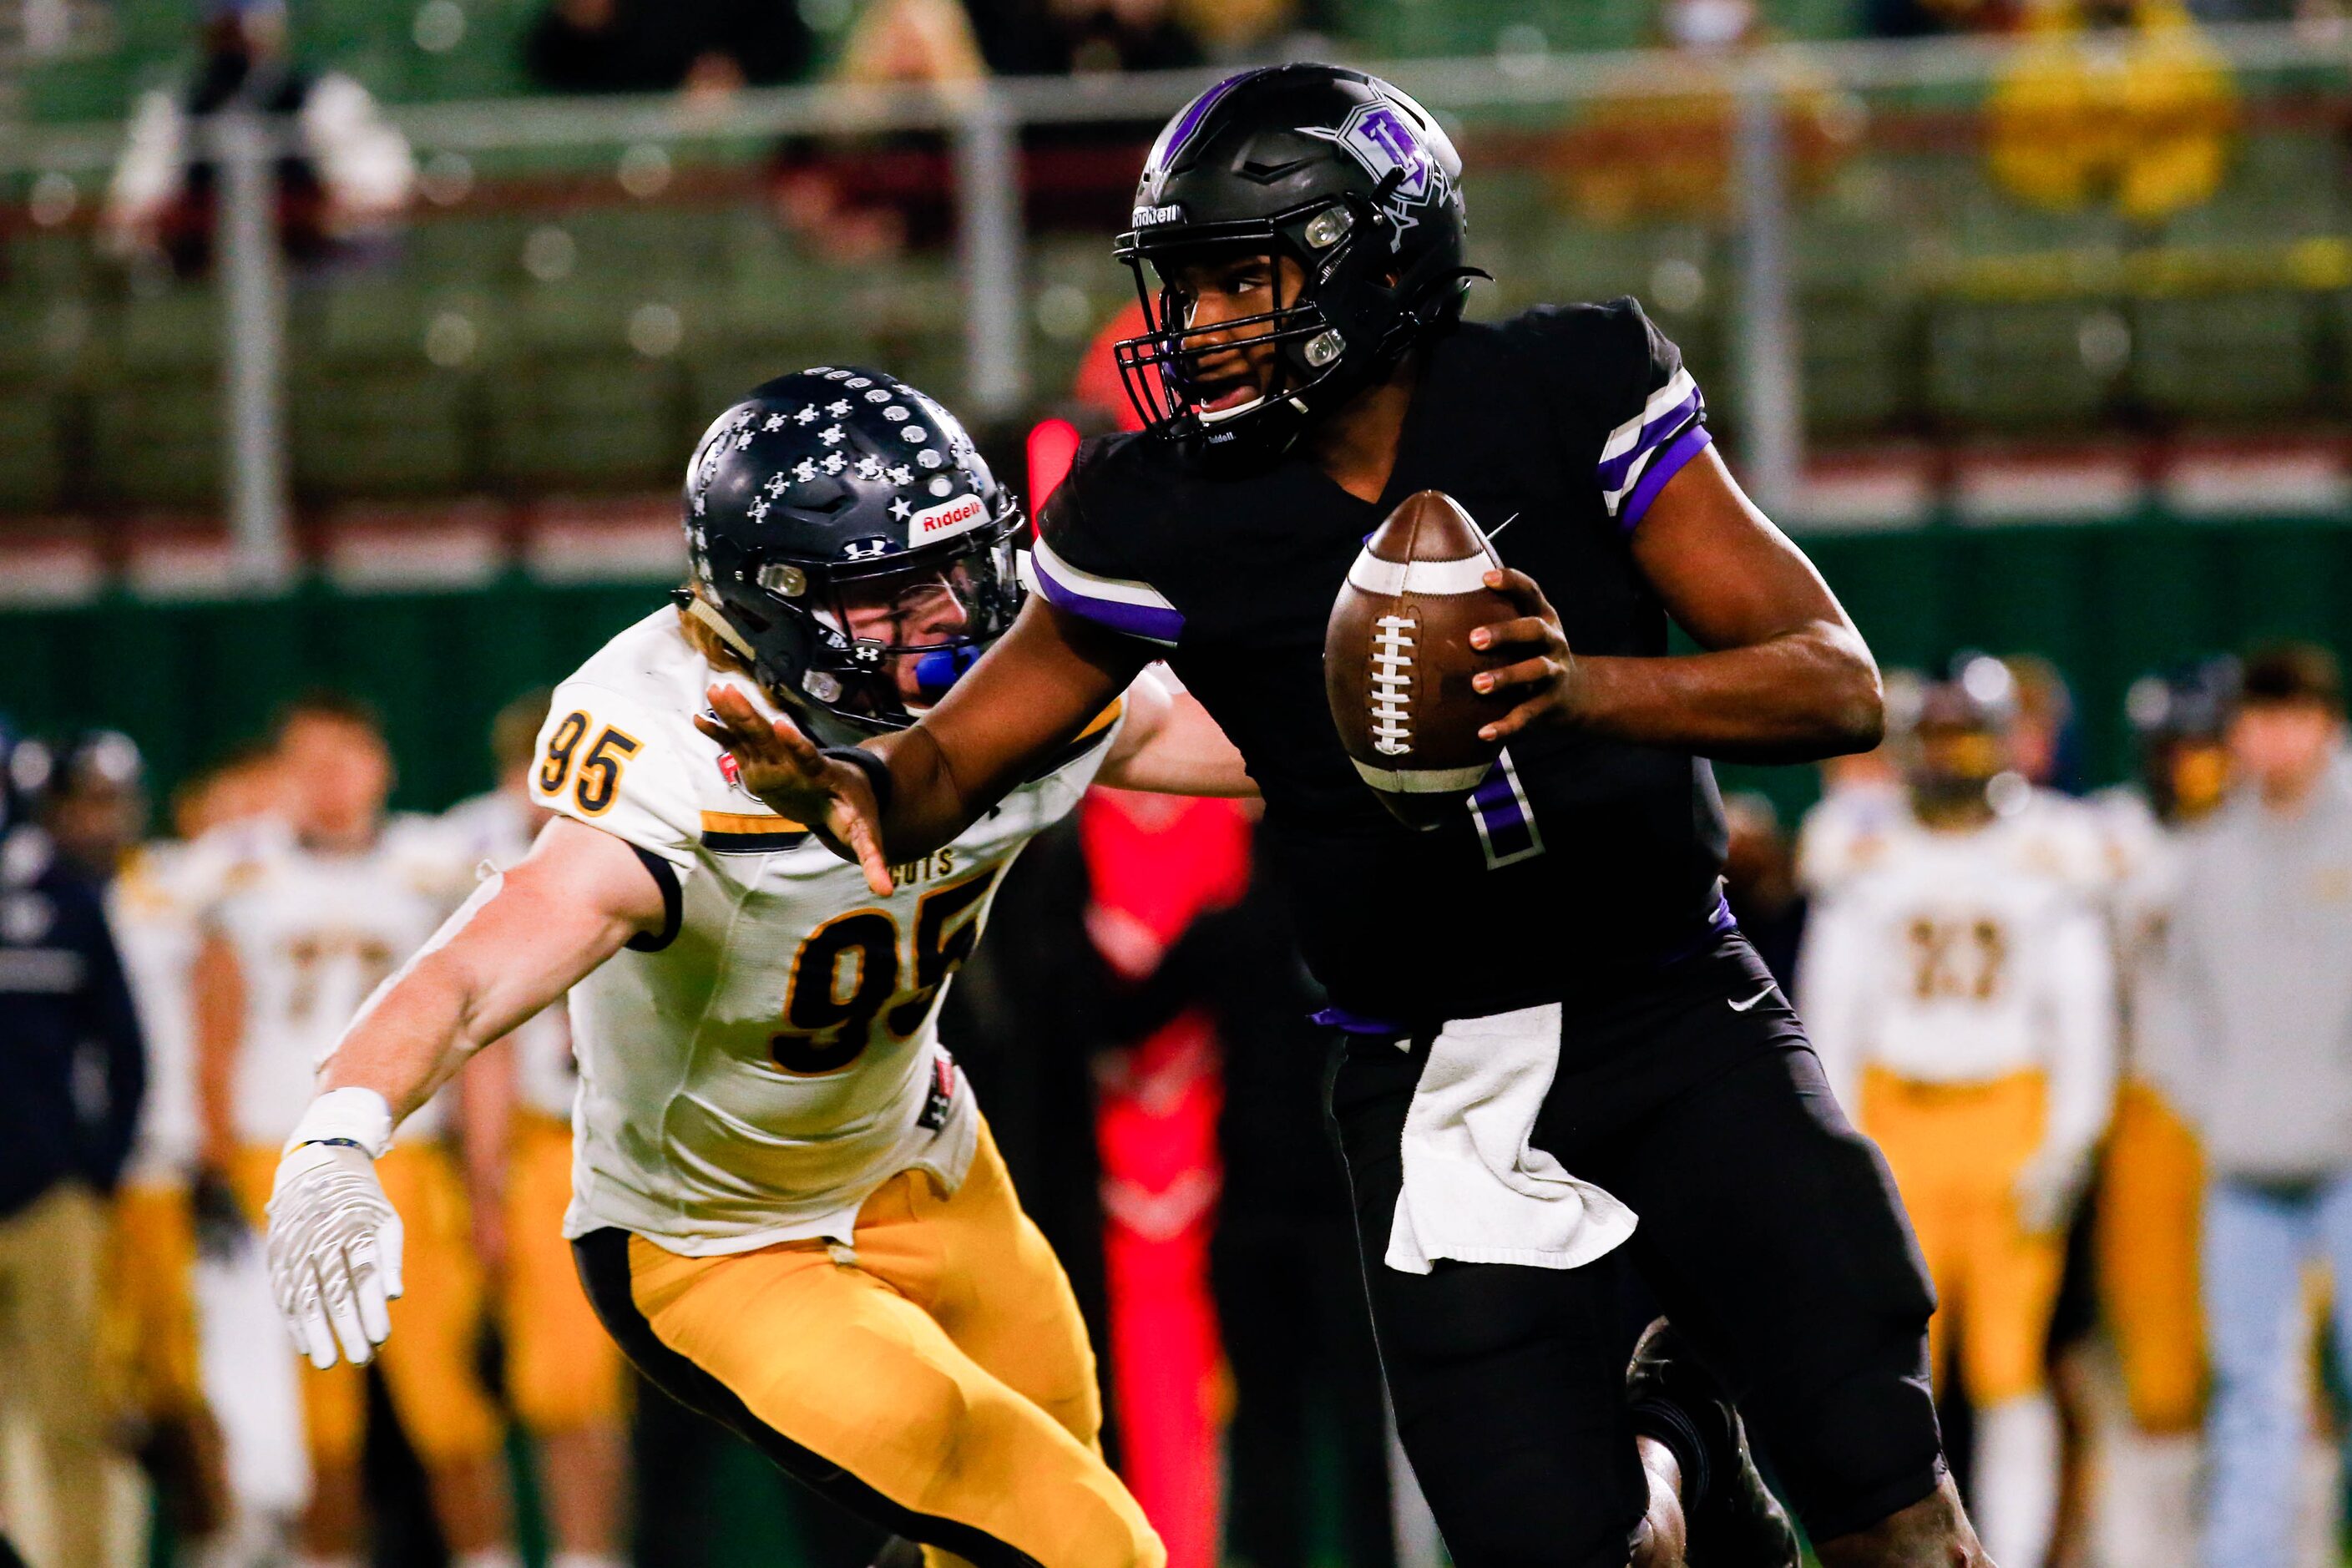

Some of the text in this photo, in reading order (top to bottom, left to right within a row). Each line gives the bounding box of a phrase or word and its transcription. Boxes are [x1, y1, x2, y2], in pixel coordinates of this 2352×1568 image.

[1132, 205, 1176, 228] Riddell
[923, 502, 980, 532] Riddell
[539, 709, 645, 817] 95
[767, 864, 1000, 1078] 95
